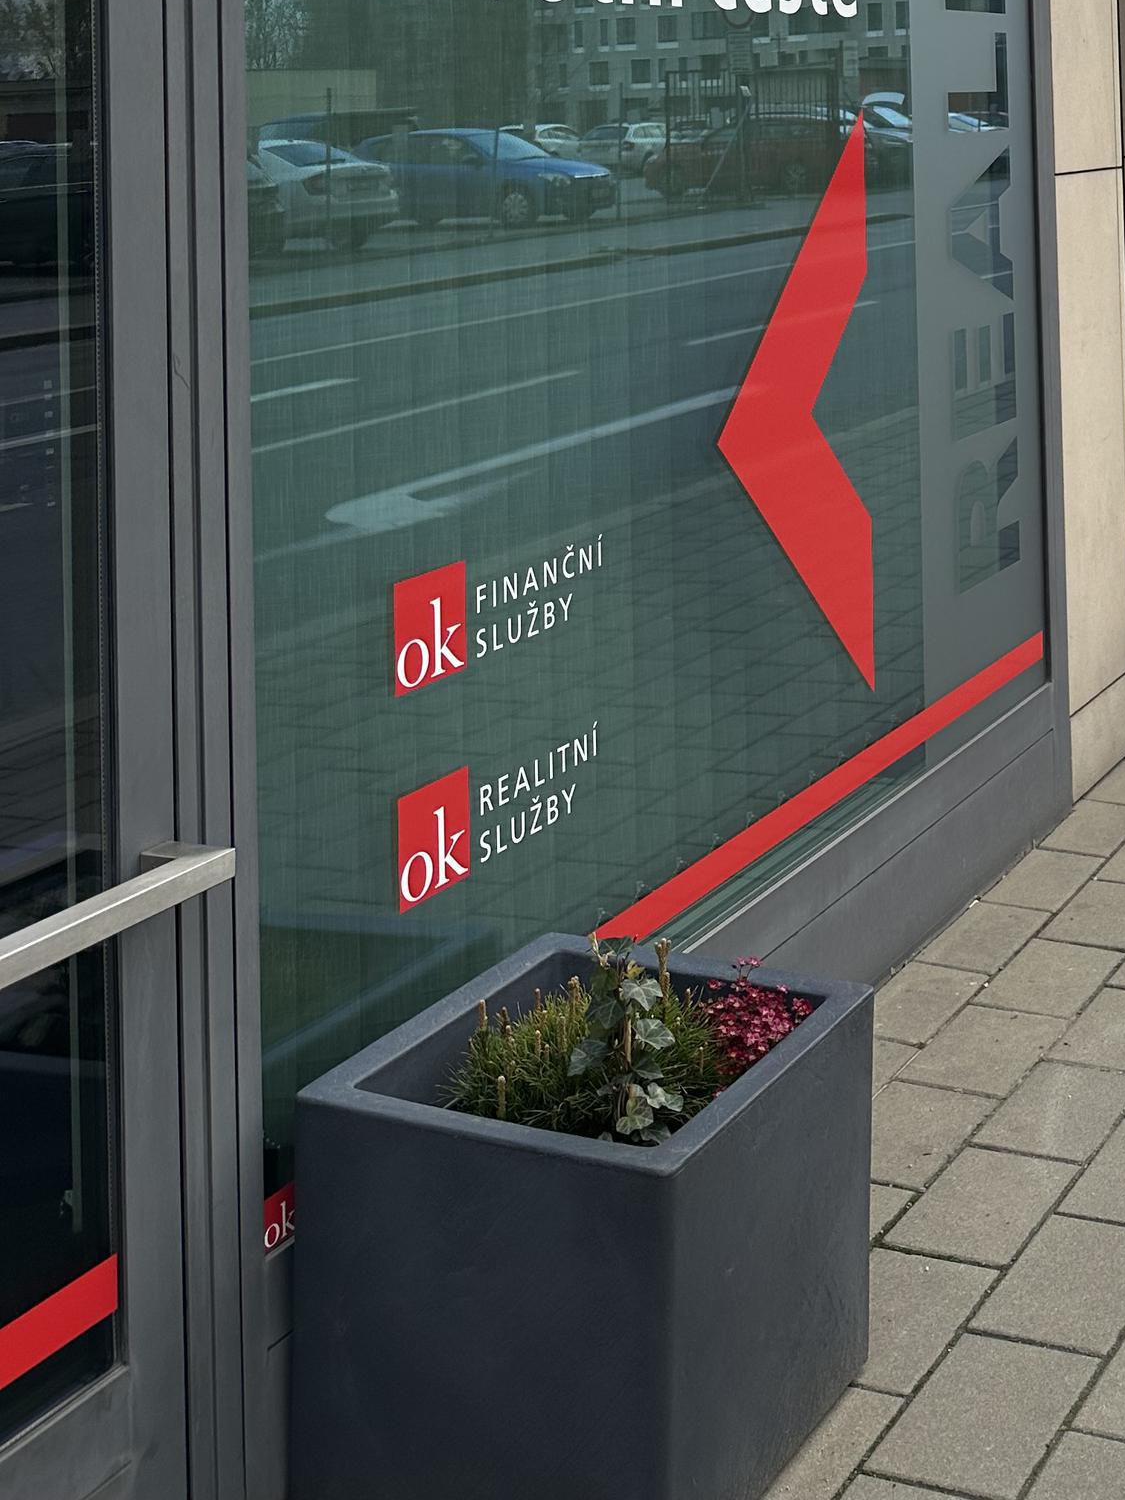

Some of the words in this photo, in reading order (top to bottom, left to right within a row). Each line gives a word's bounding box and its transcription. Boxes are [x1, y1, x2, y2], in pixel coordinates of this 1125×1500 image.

[396, 597, 464, 688] ok
[475, 534, 604, 613] FINANČNÍ
[475, 594, 575, 658] SLUŽBY
[400, 806, 468, 902] ok
[478, 721, 600, 816] REALITNÍ
[479, 784, 578, 863] SLUŽBY
[264, 1200, 295, 1248] ok
